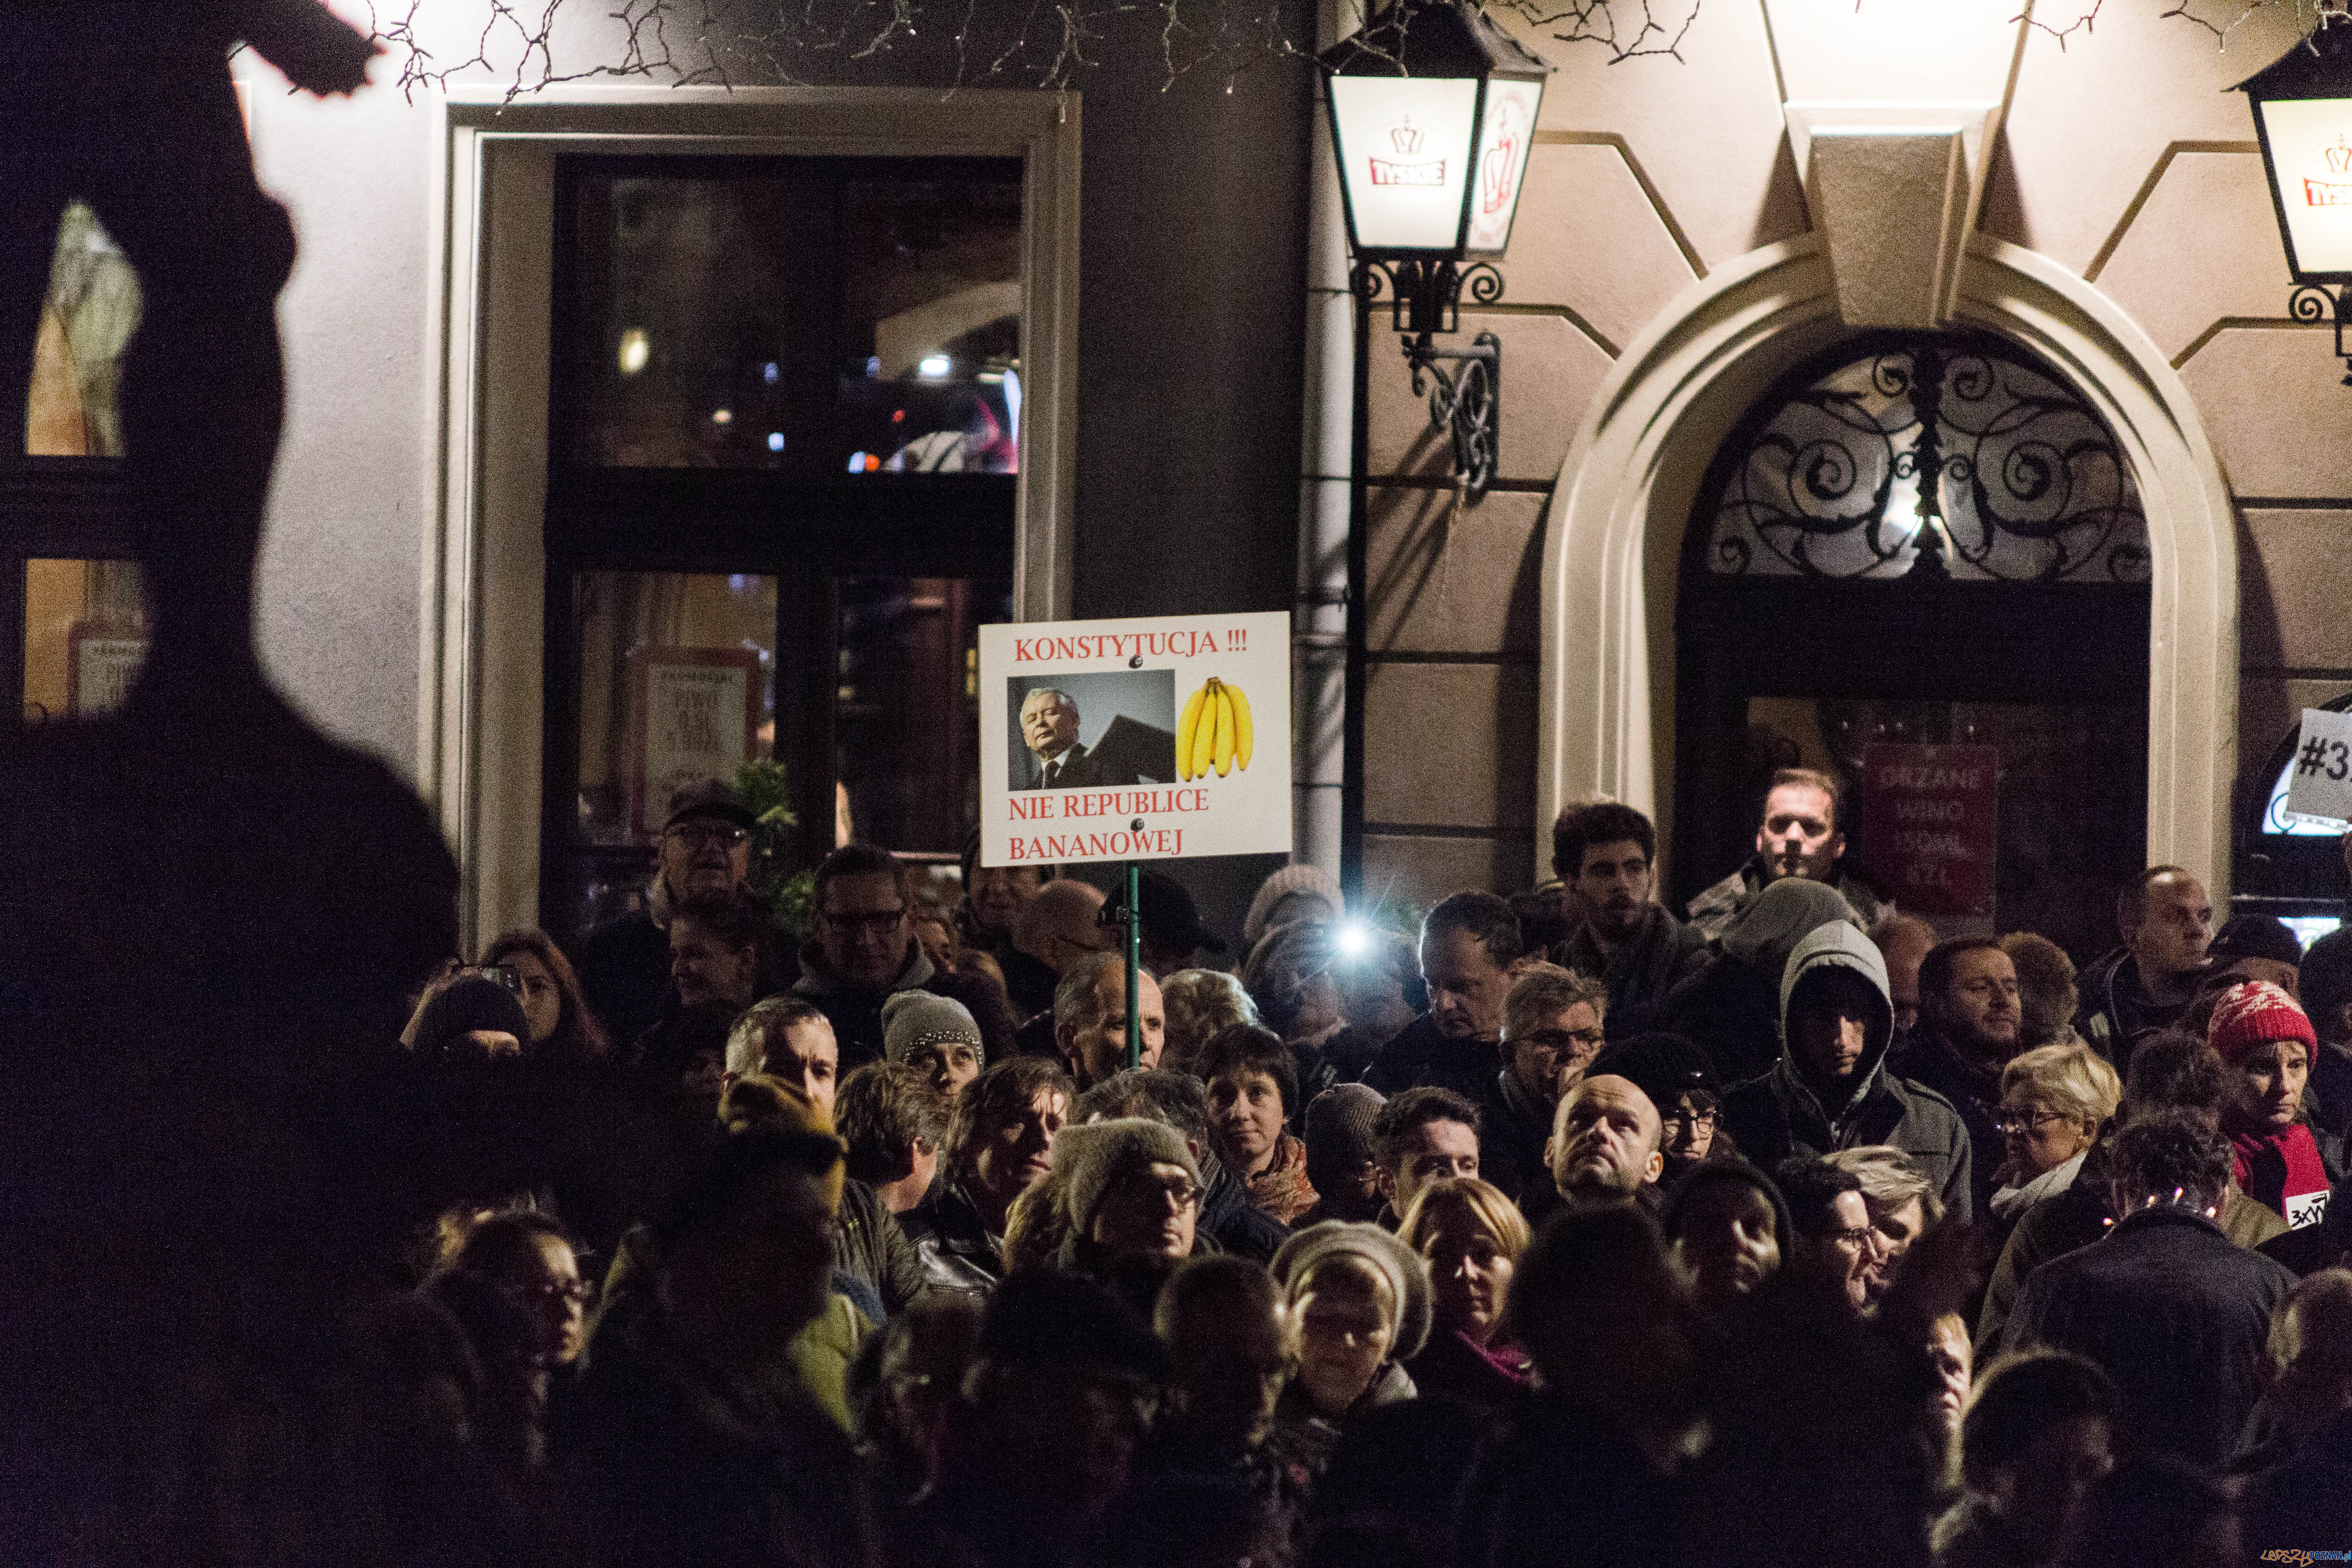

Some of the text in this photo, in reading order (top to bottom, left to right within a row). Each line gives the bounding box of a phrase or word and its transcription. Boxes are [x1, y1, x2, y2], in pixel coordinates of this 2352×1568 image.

[1372, 161, 1444, 184] TYSKIE
[1015, 629, 1247, 662] KONSTYTUCJA !!!
[1009, 789, 1209, 820] NIE REPUBLICE
[1009, 829, 1183, 860] BANANOWEJ
